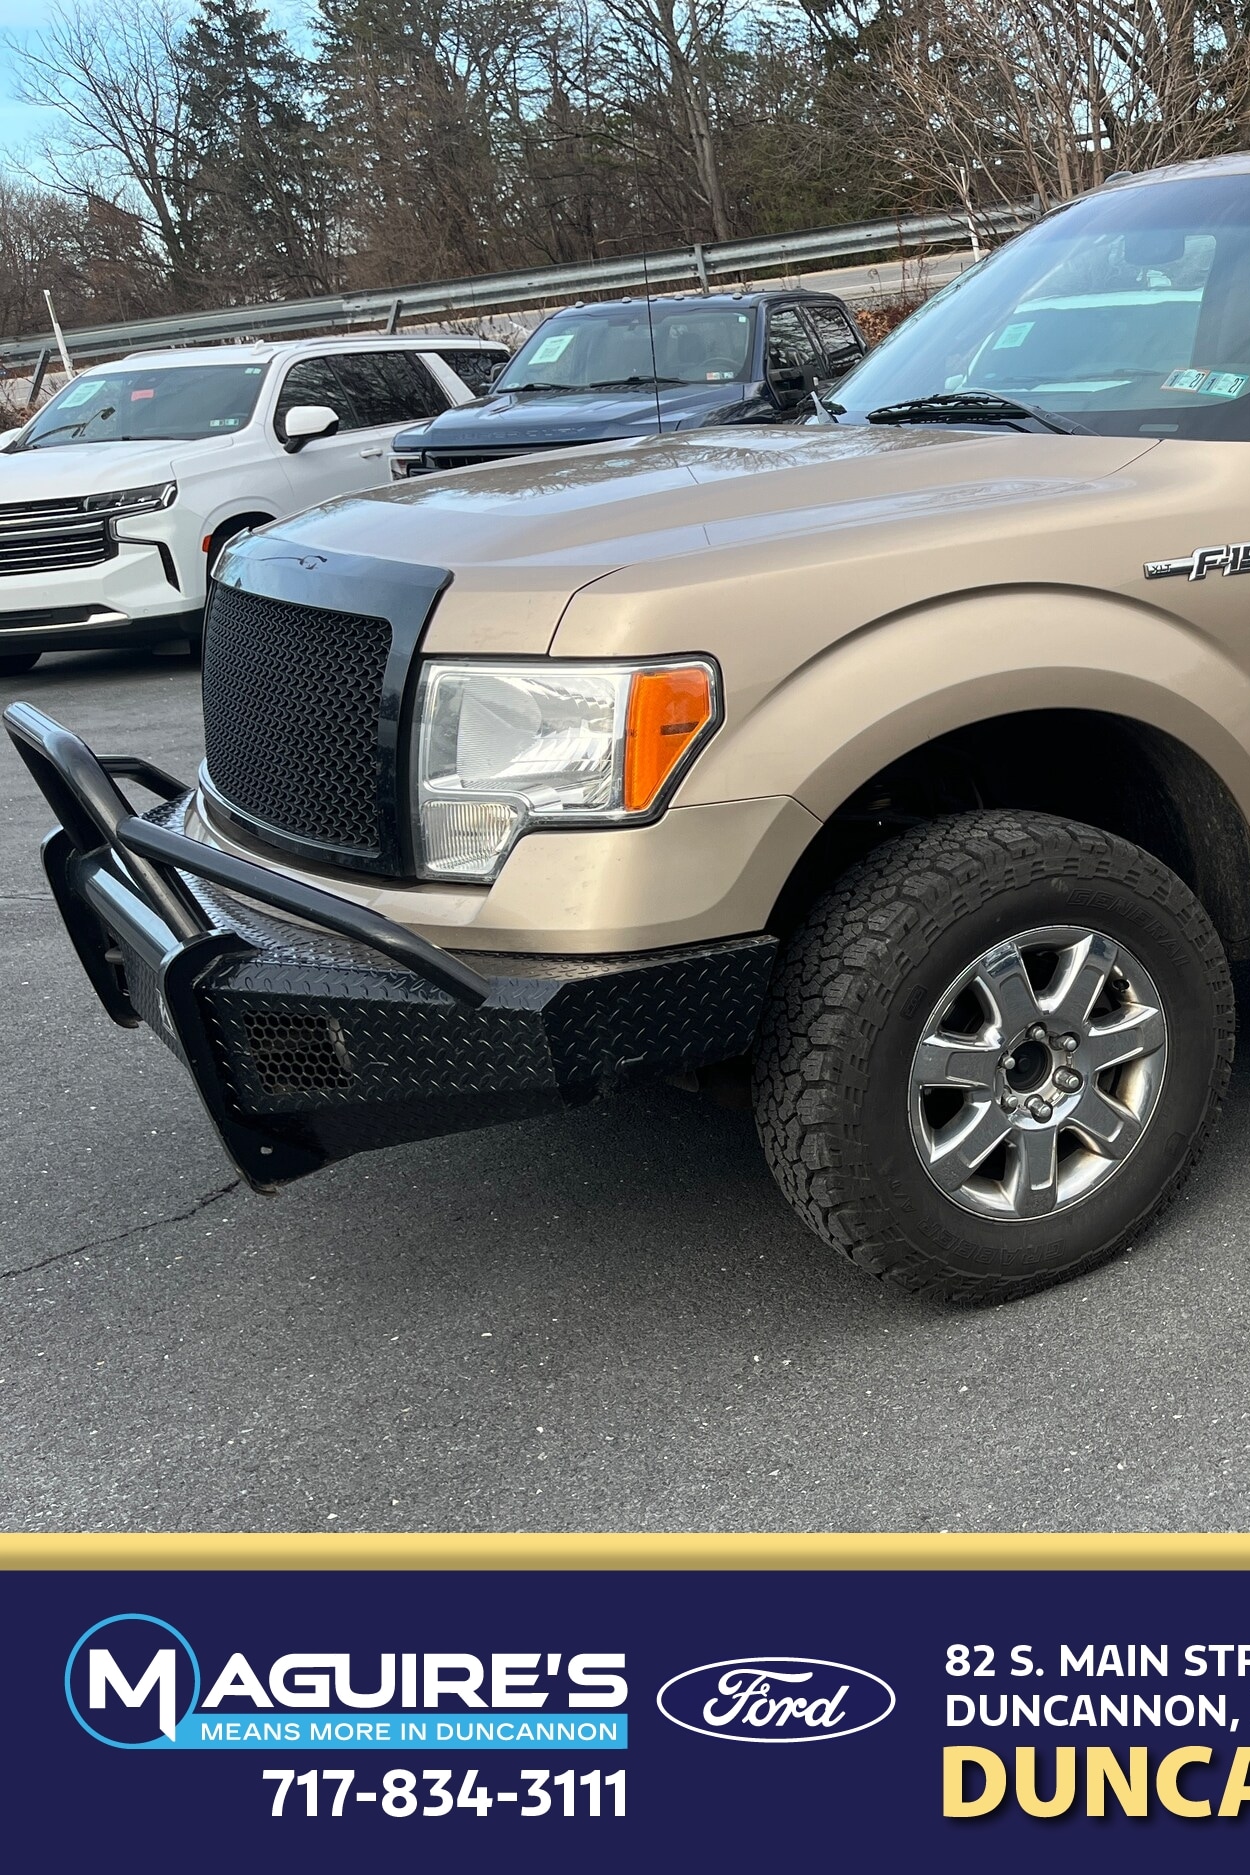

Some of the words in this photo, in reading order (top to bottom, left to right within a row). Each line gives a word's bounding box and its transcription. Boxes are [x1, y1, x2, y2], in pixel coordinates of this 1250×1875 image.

[1228, 377, 1244, 394] 27
[1151, 563, 1172, 575] XLT
[1066, 888, 1191, 977] GENERAL
[916, 1217, 1066, 1266] GRABBER
